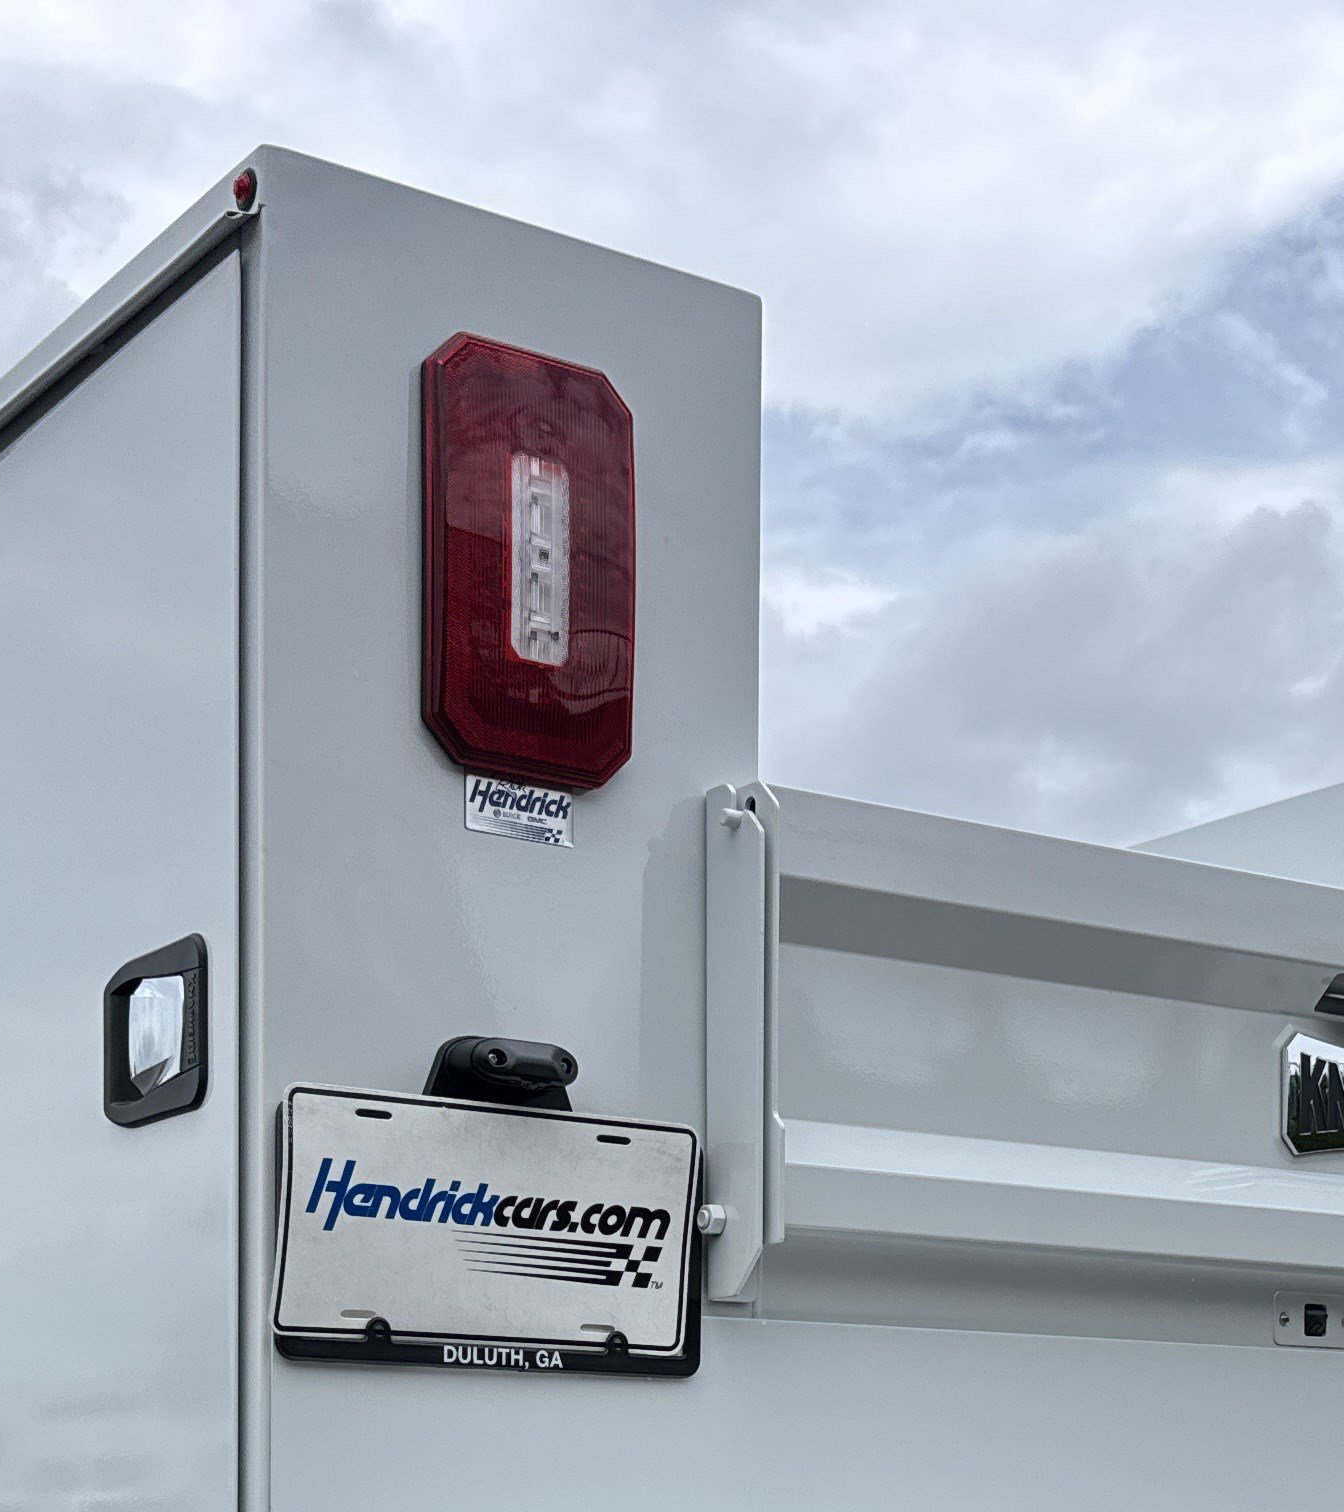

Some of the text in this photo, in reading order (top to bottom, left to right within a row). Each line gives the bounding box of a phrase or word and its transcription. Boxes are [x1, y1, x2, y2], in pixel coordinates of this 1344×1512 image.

[469, 779, 571, 819] Hendrick
[305, 1158, 670, 1240] Hendrickcars.com
[443, 1345, 563, 1369] DULUTH, GA
